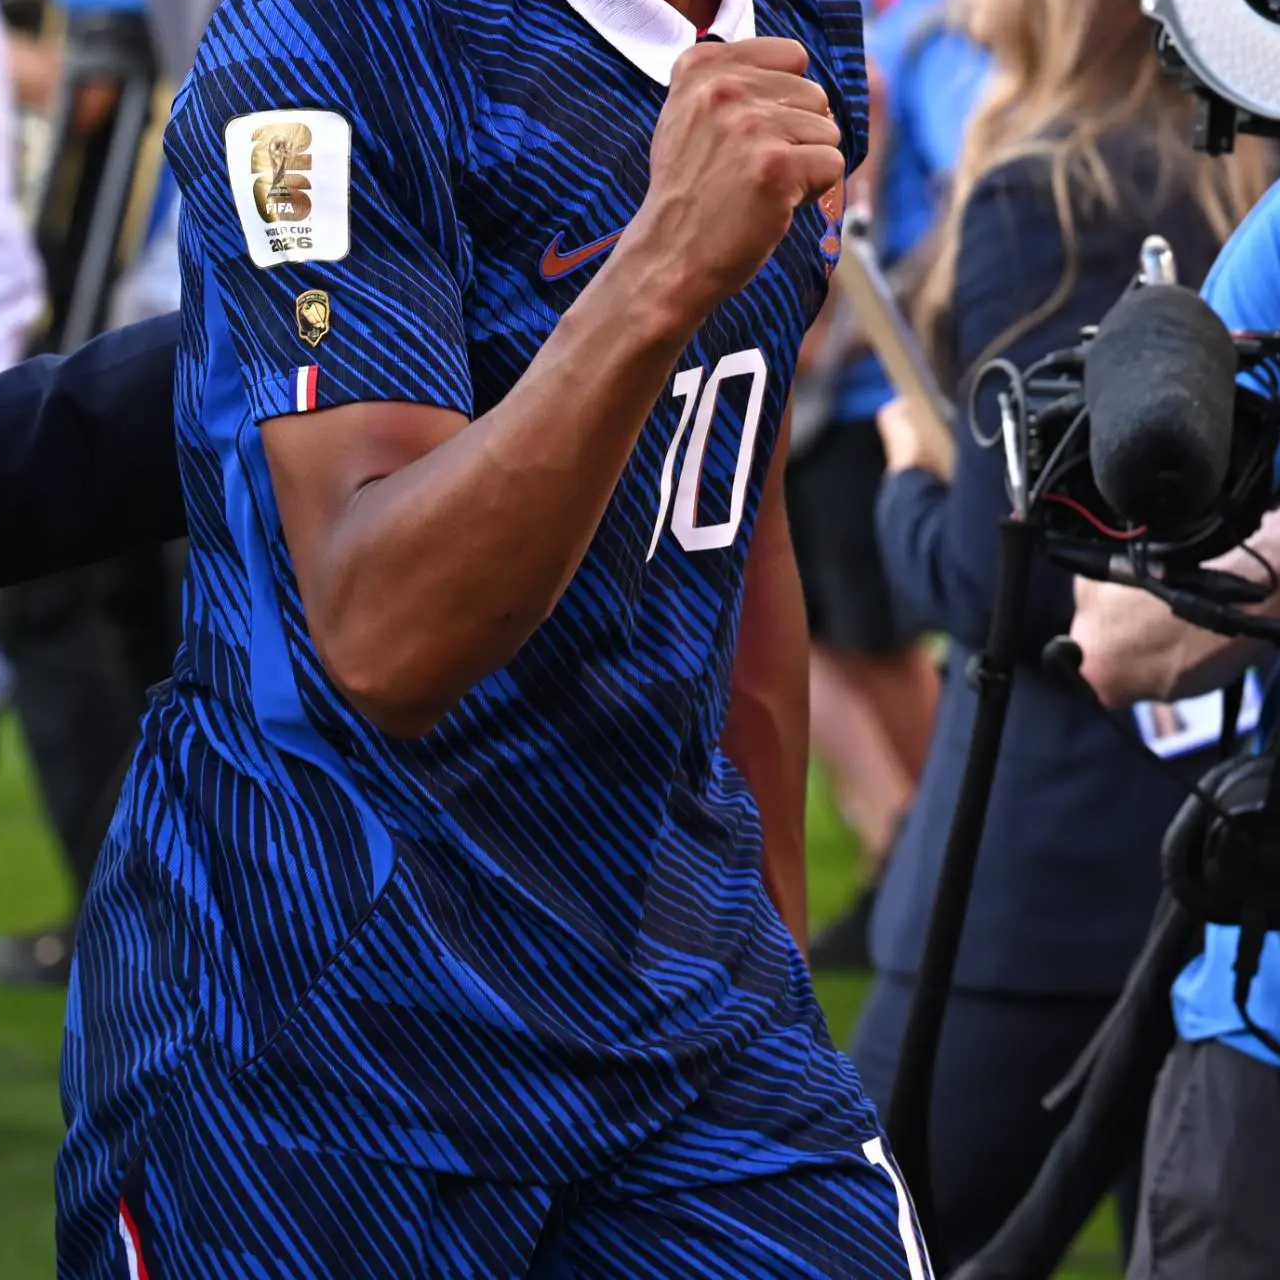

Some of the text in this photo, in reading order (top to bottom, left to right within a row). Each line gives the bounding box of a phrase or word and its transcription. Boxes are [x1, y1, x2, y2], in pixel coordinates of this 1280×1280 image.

[265, 202, 295, 215] FIFA
[290, 226, 312, 234] CUP
[269, 236, 313, 252] 2026
[646, 347, 768, 563] 10
